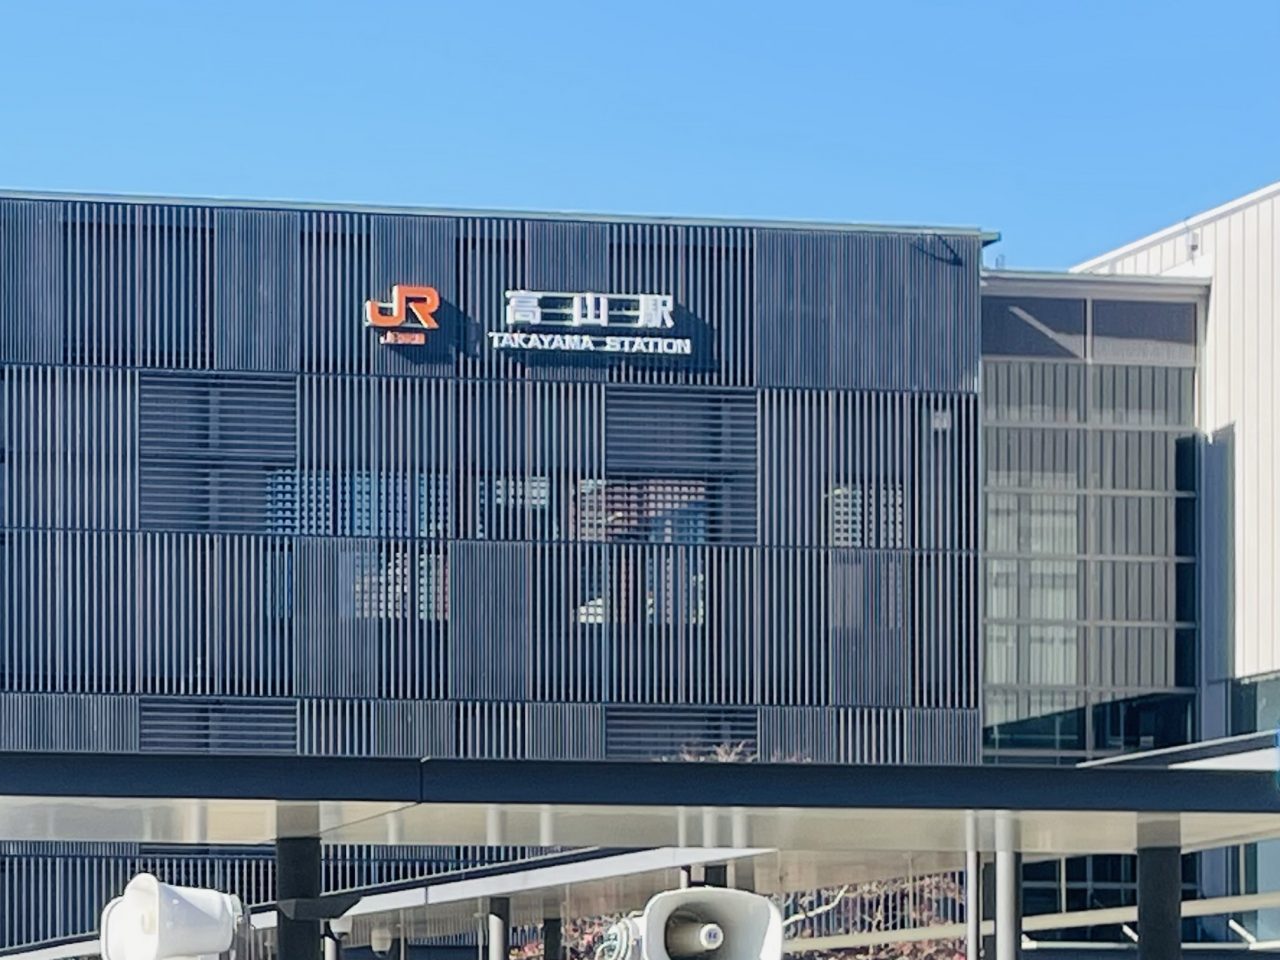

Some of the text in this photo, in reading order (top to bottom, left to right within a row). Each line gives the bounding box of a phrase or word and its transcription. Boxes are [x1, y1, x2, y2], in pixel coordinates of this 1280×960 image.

[365, 284, 440, 329] JR
[504, 290, 674, 328] 高山駅
[488, 332, 691, 354] TAKAYAMA STATION
